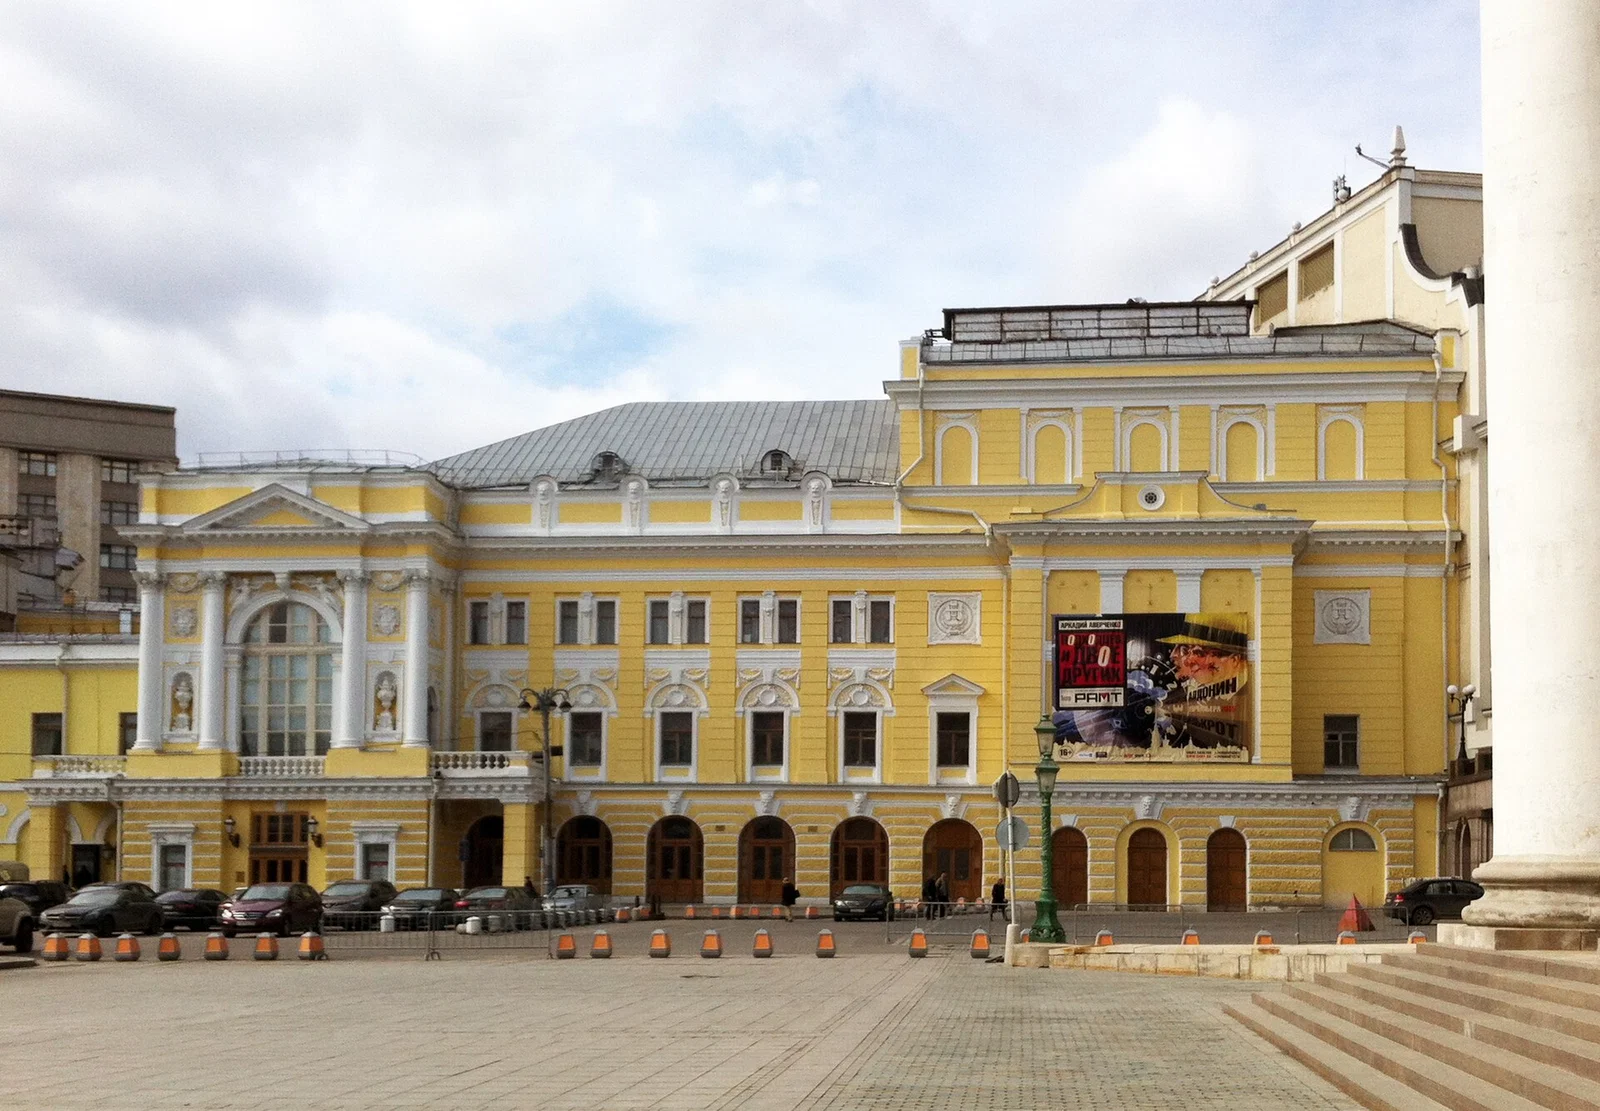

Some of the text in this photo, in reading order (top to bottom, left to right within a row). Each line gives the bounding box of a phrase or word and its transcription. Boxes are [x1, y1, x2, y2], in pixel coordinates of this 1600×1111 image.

[1060, 620, 1121, 629] АРКАДИЙ АВЕРЧЕНКО
[1073, 646, 1121, 667] ДВОЕ
[1063, 668, 1121, 685] ДРУГИХ
[1074, 692, 1122, 703] РАМТ
[1060, 748, 1073, 757] 16+
